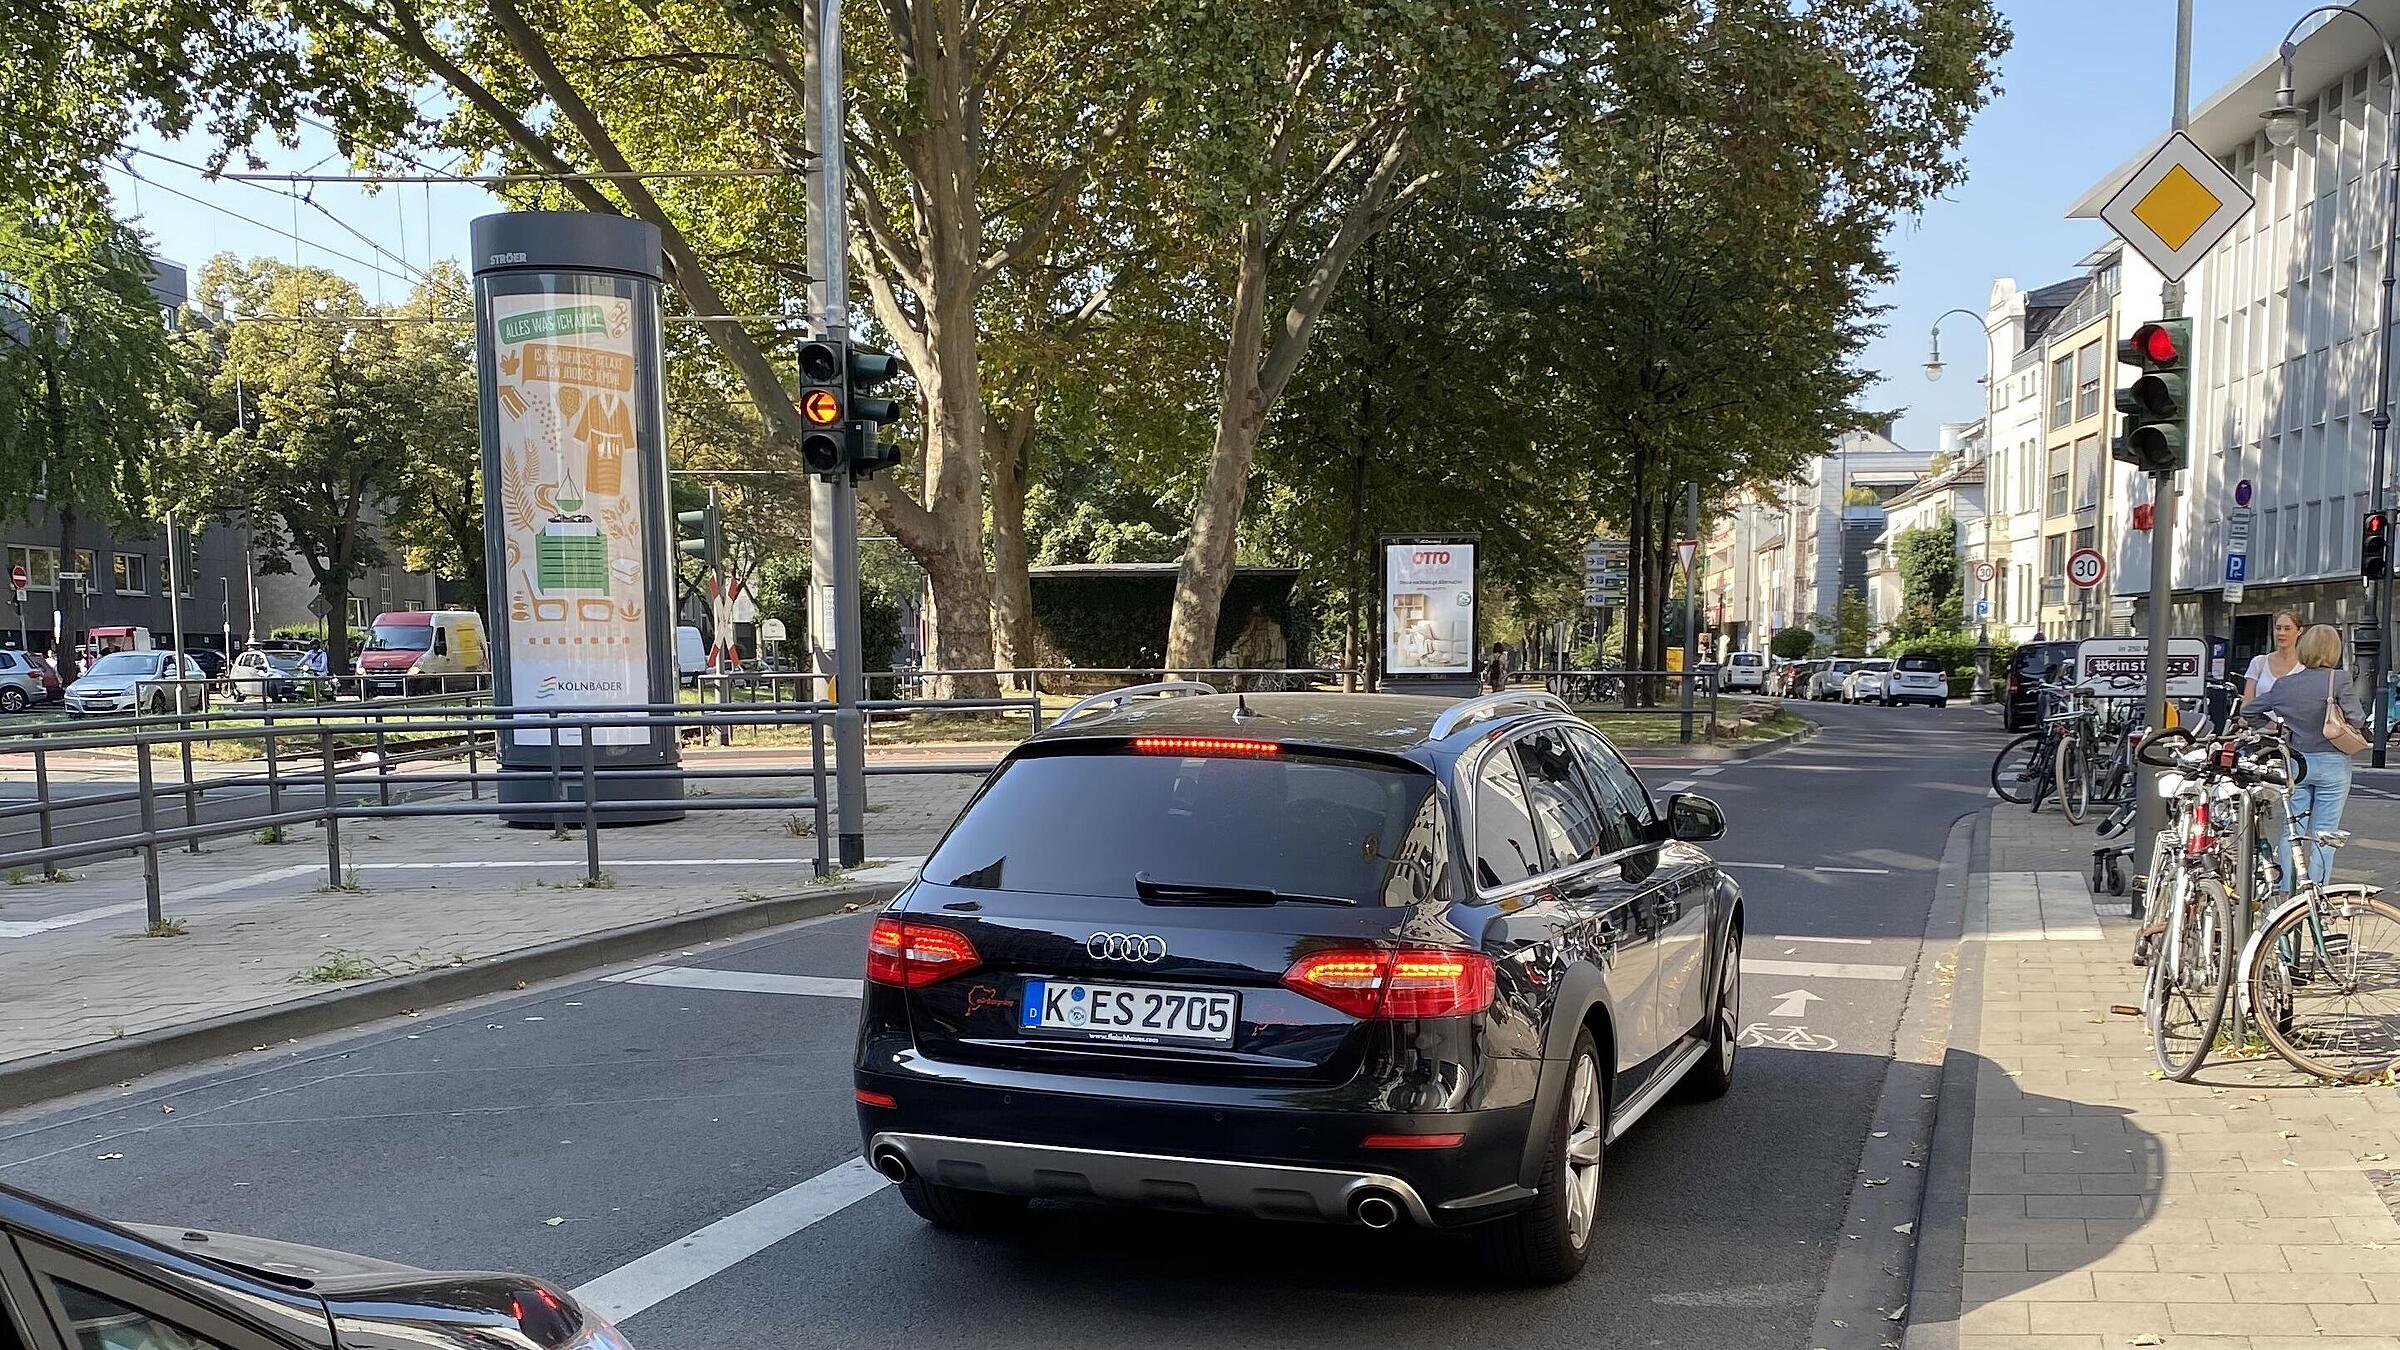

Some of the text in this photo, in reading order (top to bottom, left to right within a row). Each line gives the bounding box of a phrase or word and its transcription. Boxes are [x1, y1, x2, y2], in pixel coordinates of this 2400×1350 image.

[490, 252, 527, 265] STRÖER
[506, 319, 531, 339] ALLES
[531, 316, 555, 333] WAS
[556, 313, 575, 331] ICH
[1413, 551, 1450, 565] OTTO
[1979, 568, 1991, 577] 30
[2075, 560, 2098, 577] 30
[2230, 557, 2242, 578] P
[558, 680, 622, 691] KÖLNBÄDER
[1029, 1007, 1038, 1019] D
[1046, 988, 1231, 1032] K ES 2705
